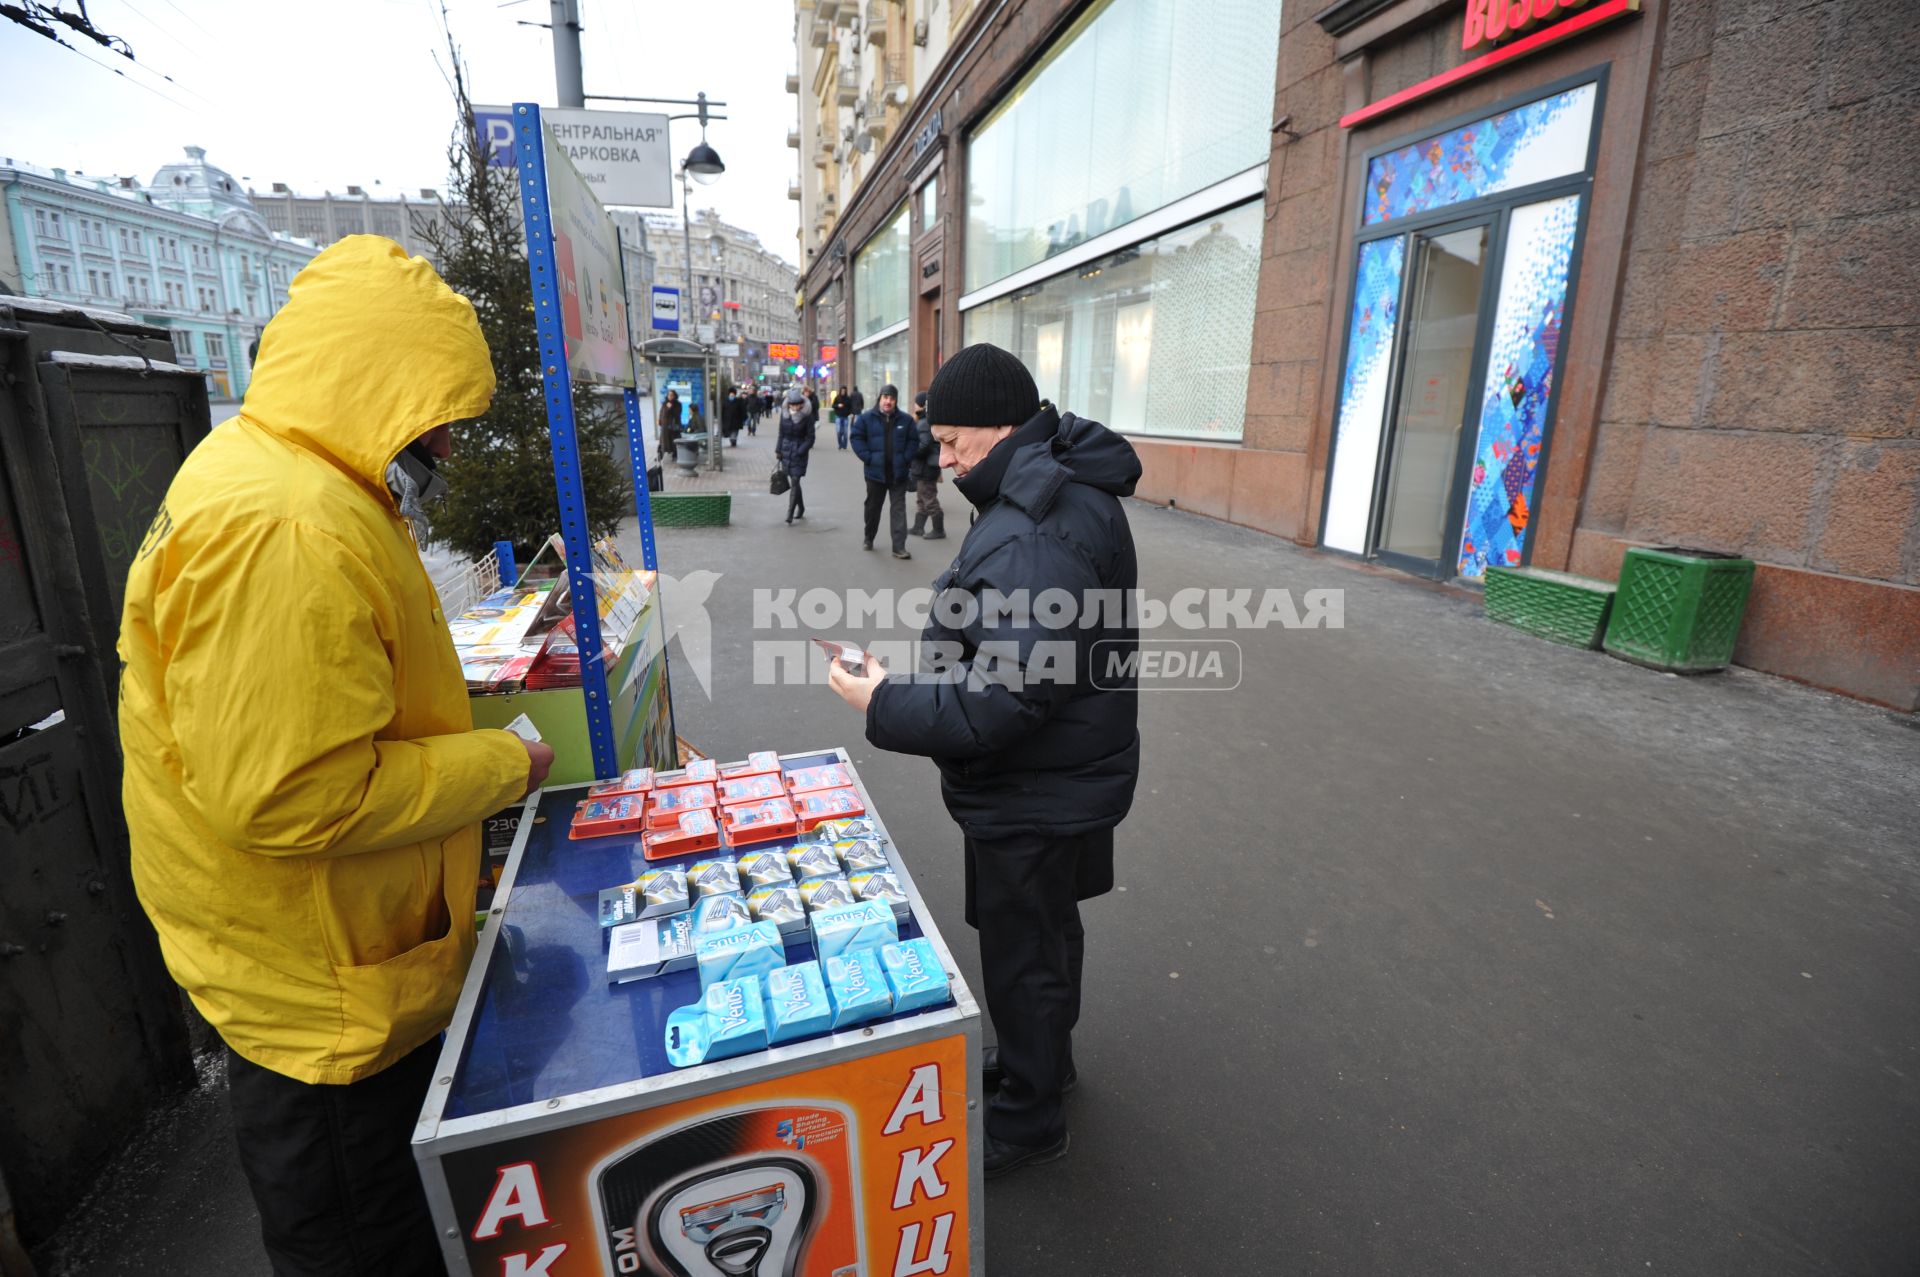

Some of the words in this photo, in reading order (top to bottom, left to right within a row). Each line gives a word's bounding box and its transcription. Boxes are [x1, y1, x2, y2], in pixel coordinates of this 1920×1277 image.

[547, 122, 663, 143] ЕНТРАЛЬНАЯ"
[825, 906, 888, 925] Venus
[707, 928, 774, 951] Venus
[904, 943, 930, 991] Venus
[844, 957, 871, 1005] Venus
[784, 968, 811, 1019] Venus
[720, 984, 748, 1036] Venus
[796, 1117, 827, 1129] Shaving
[806, 1127, 844, 1141] Precision
[806, 1134, 838, 1146] Trimmer
